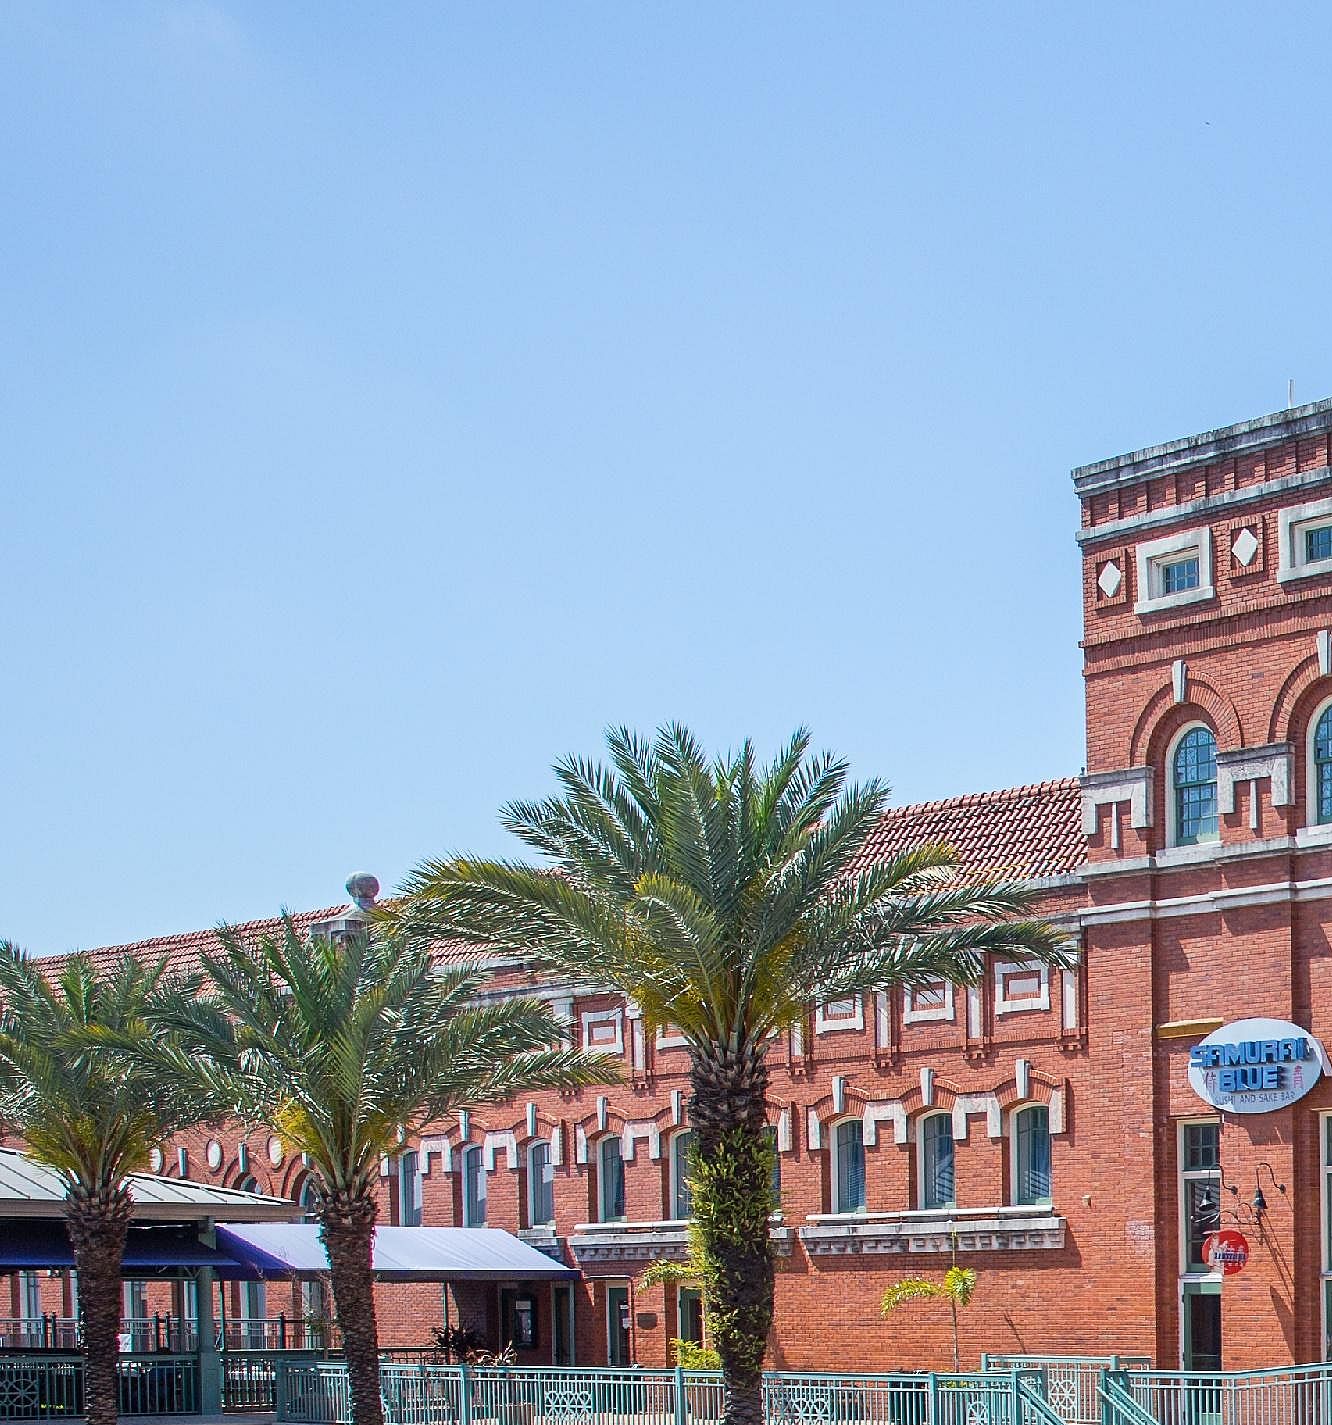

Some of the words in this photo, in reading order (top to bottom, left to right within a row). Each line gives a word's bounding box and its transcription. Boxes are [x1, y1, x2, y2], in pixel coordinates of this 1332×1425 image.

[1190, 1038, 1309, 1067] SAMURAI
[1220, 1067, 1281, 1092] BLUE
[1214, 1096, 1236, 1106] SUSHI
[1240, 1094, 1256, 1104] AND
[1259, 1093, 1278, 1103] SAKE
[1280, 1091, 1296, 1102] BAR
